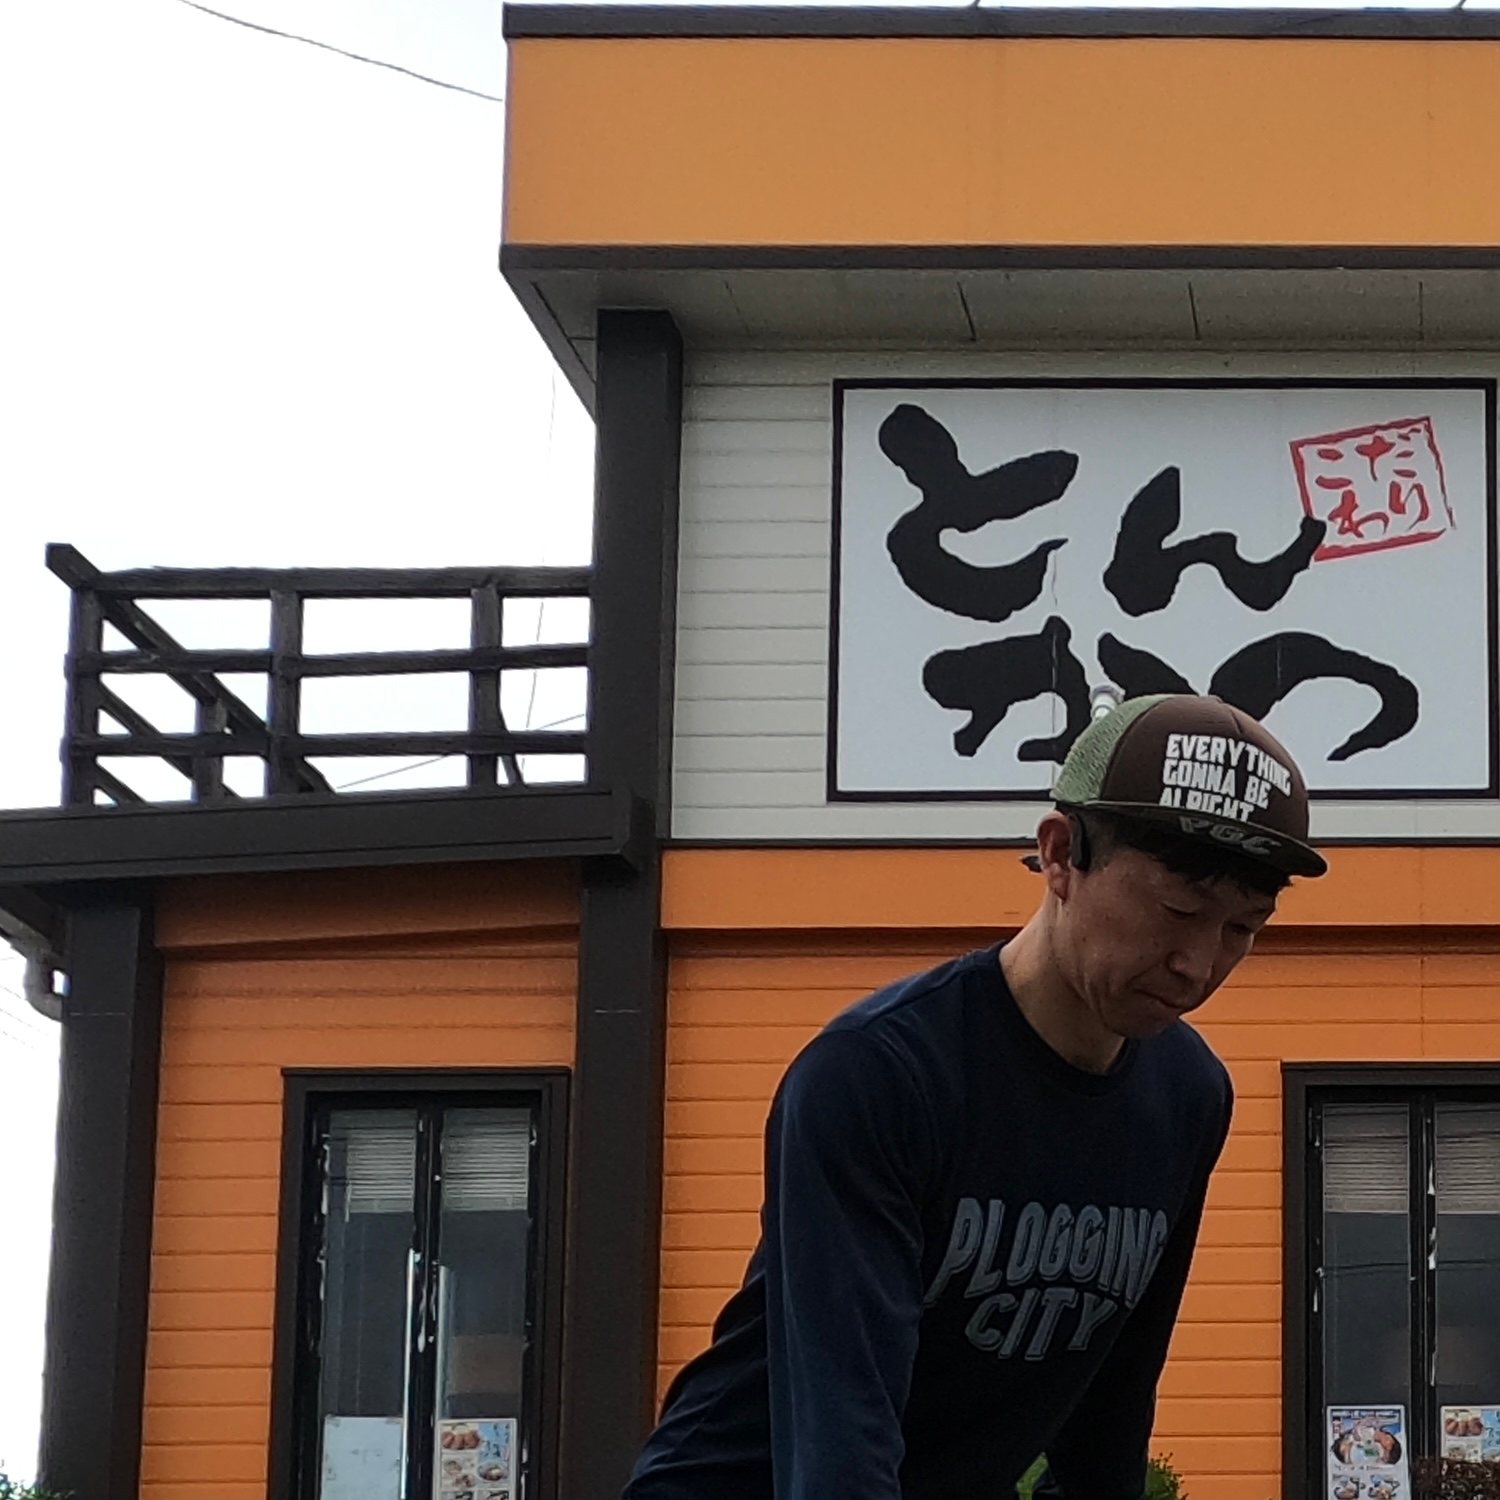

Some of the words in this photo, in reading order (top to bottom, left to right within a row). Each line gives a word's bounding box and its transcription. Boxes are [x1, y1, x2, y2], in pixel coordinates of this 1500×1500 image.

[879, 403, 1326, 622] とん
[922, 616, 1419, 762] かつ
[1162, 759, 1235, 797] GONNA
[1244, 775, 1272, 809] BE
[1166, 734, 1291, 797] EVERYTHING
[964, 1287, 1118, 1361] CITY
